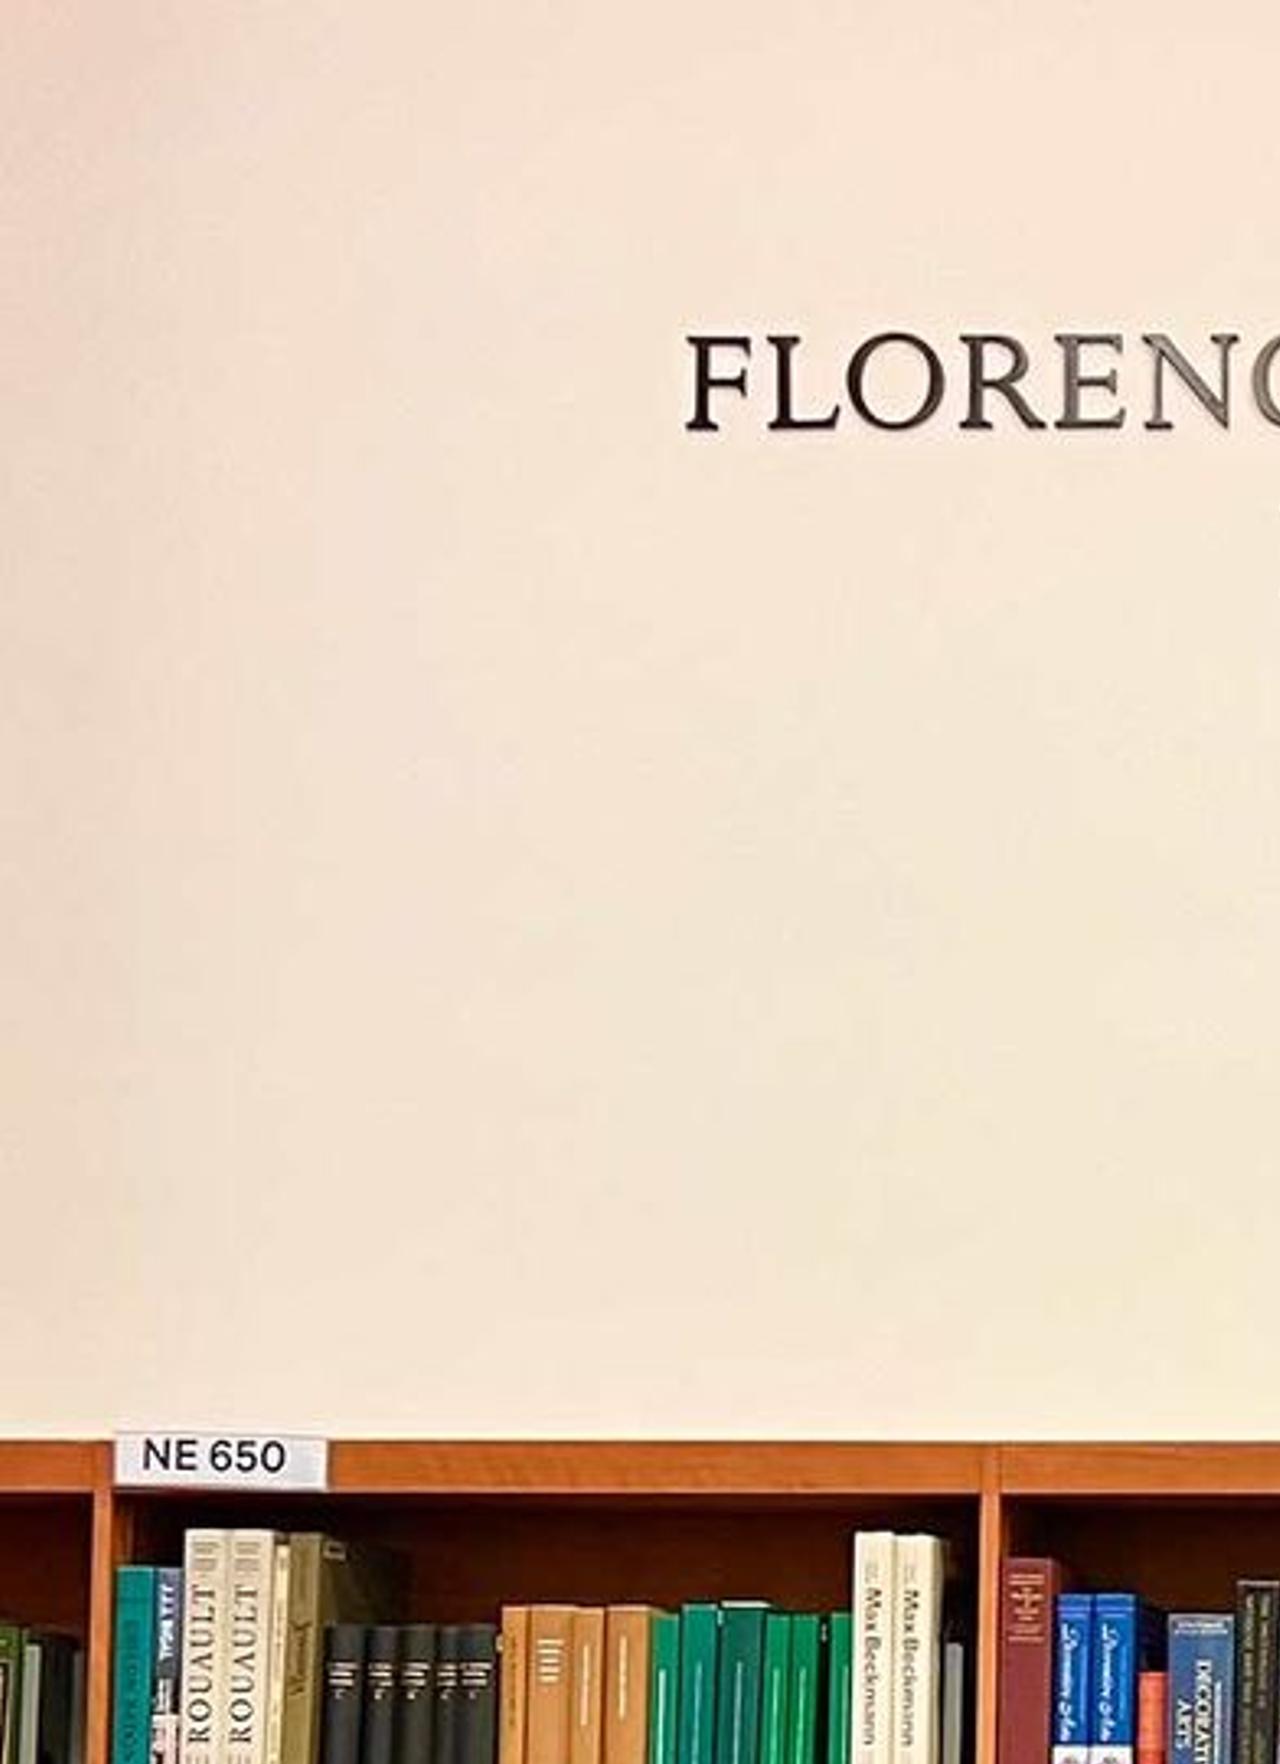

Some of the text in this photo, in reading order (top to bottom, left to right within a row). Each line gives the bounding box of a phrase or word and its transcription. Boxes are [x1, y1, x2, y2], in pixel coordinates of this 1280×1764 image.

[142, 1438, 287, 1474] NE 650
[187, 1583, 218, 1746] ROUAULT
[228, 1584, 259, 1746] ROUAULT
